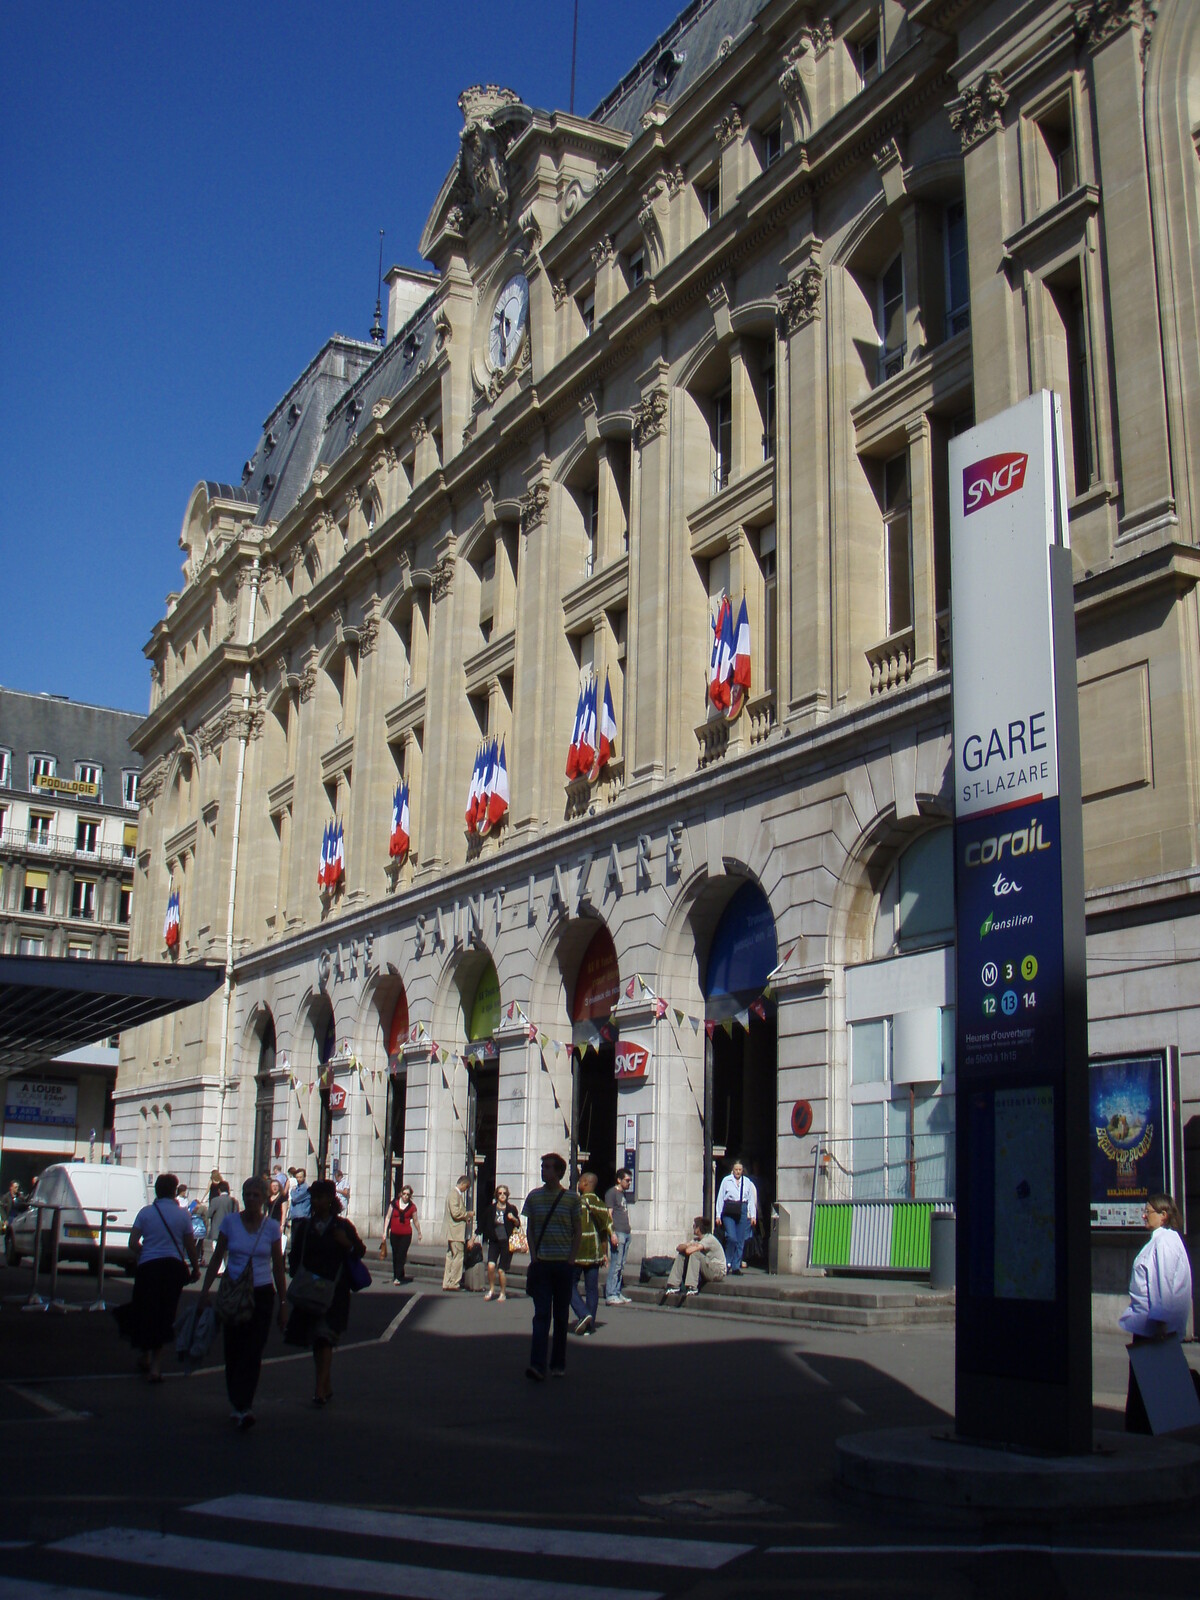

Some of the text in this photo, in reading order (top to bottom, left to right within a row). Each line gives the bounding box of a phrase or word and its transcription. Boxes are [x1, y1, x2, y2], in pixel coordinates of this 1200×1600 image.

[966, 456, 1025, 509] SNCF
[962, 711, 1047, 772] GARE
[40, 777, 94, 794] PODOLOGIE
[963, 761, 1049, 802] ST-LAZARE
[964, 818, 1051, 868] corail
[992, 872, 1023, 897] ter
[984, 913, 1034, 932] Transilien
[318, 932, 374, 981] GARE
[1005, 964, 1013, 979] 3
[1025, 960, 1033, 975] 9
[983, 992, 1036, 1013] 12 13 14
[965, 1032, 990, 1043] Heures
[614, 1052, 646, 1073] SNCF
[22, 1083, 62, 1094] A LOUER
